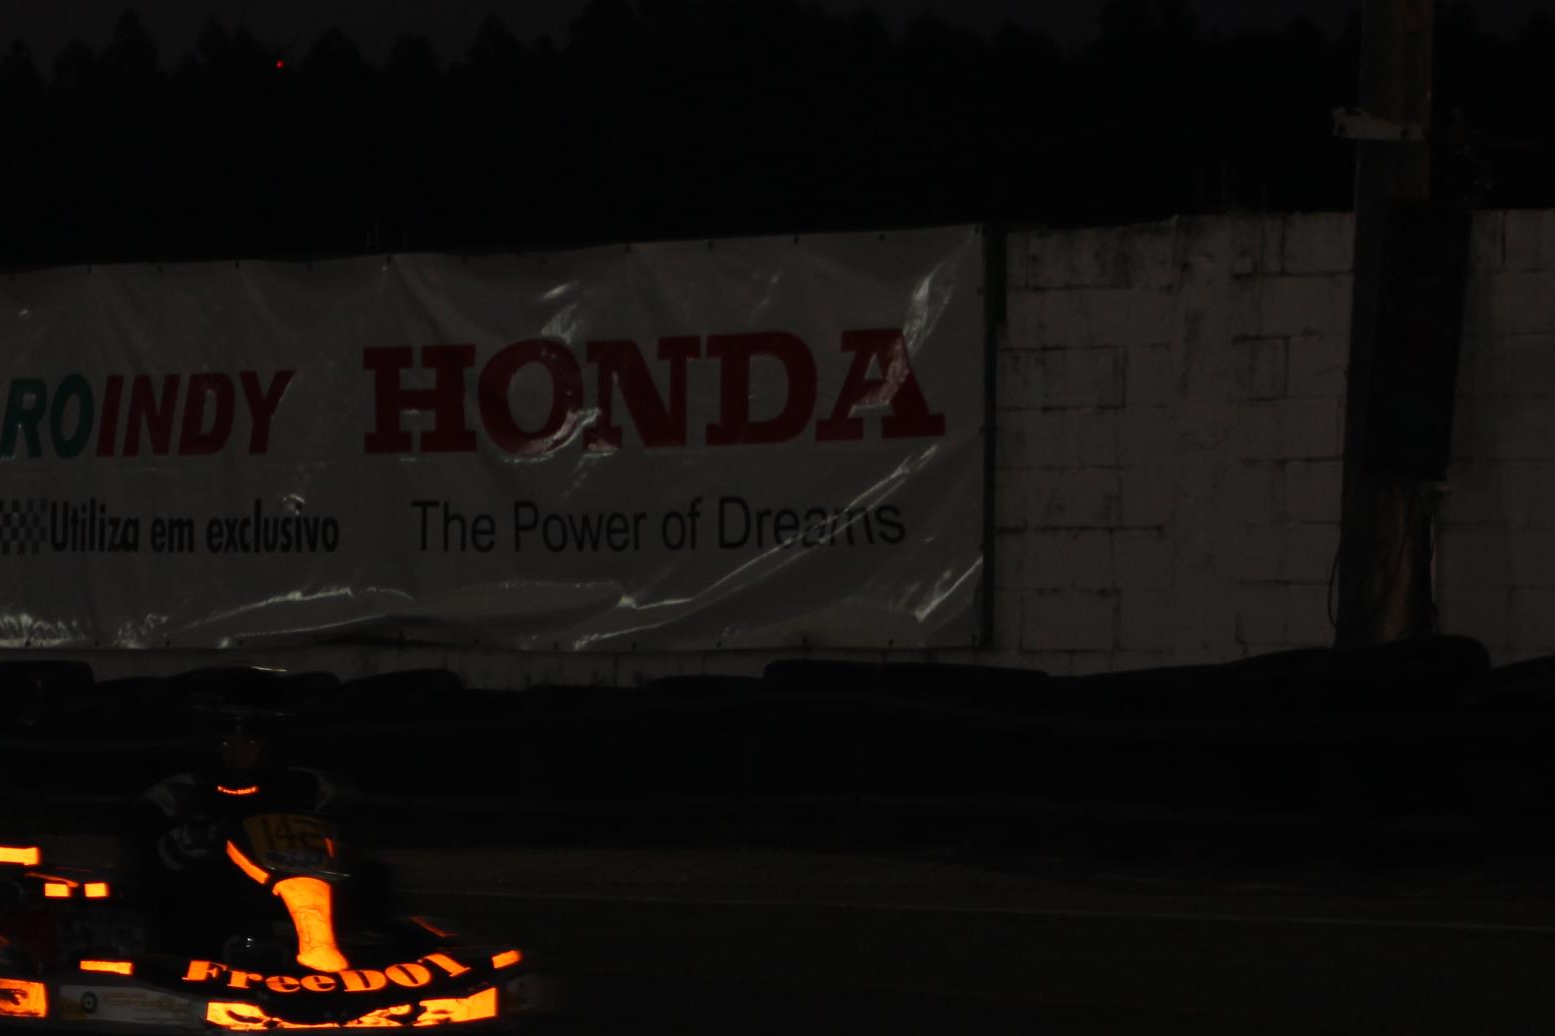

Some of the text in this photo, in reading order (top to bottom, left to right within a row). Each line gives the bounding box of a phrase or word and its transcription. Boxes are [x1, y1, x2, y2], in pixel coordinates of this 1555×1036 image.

[364, 328, 945, 455] HONDA
[49, 498, 340, 553] Utiliza em exclusivo
[411, 496, 907, 552] The Power of Dreams
